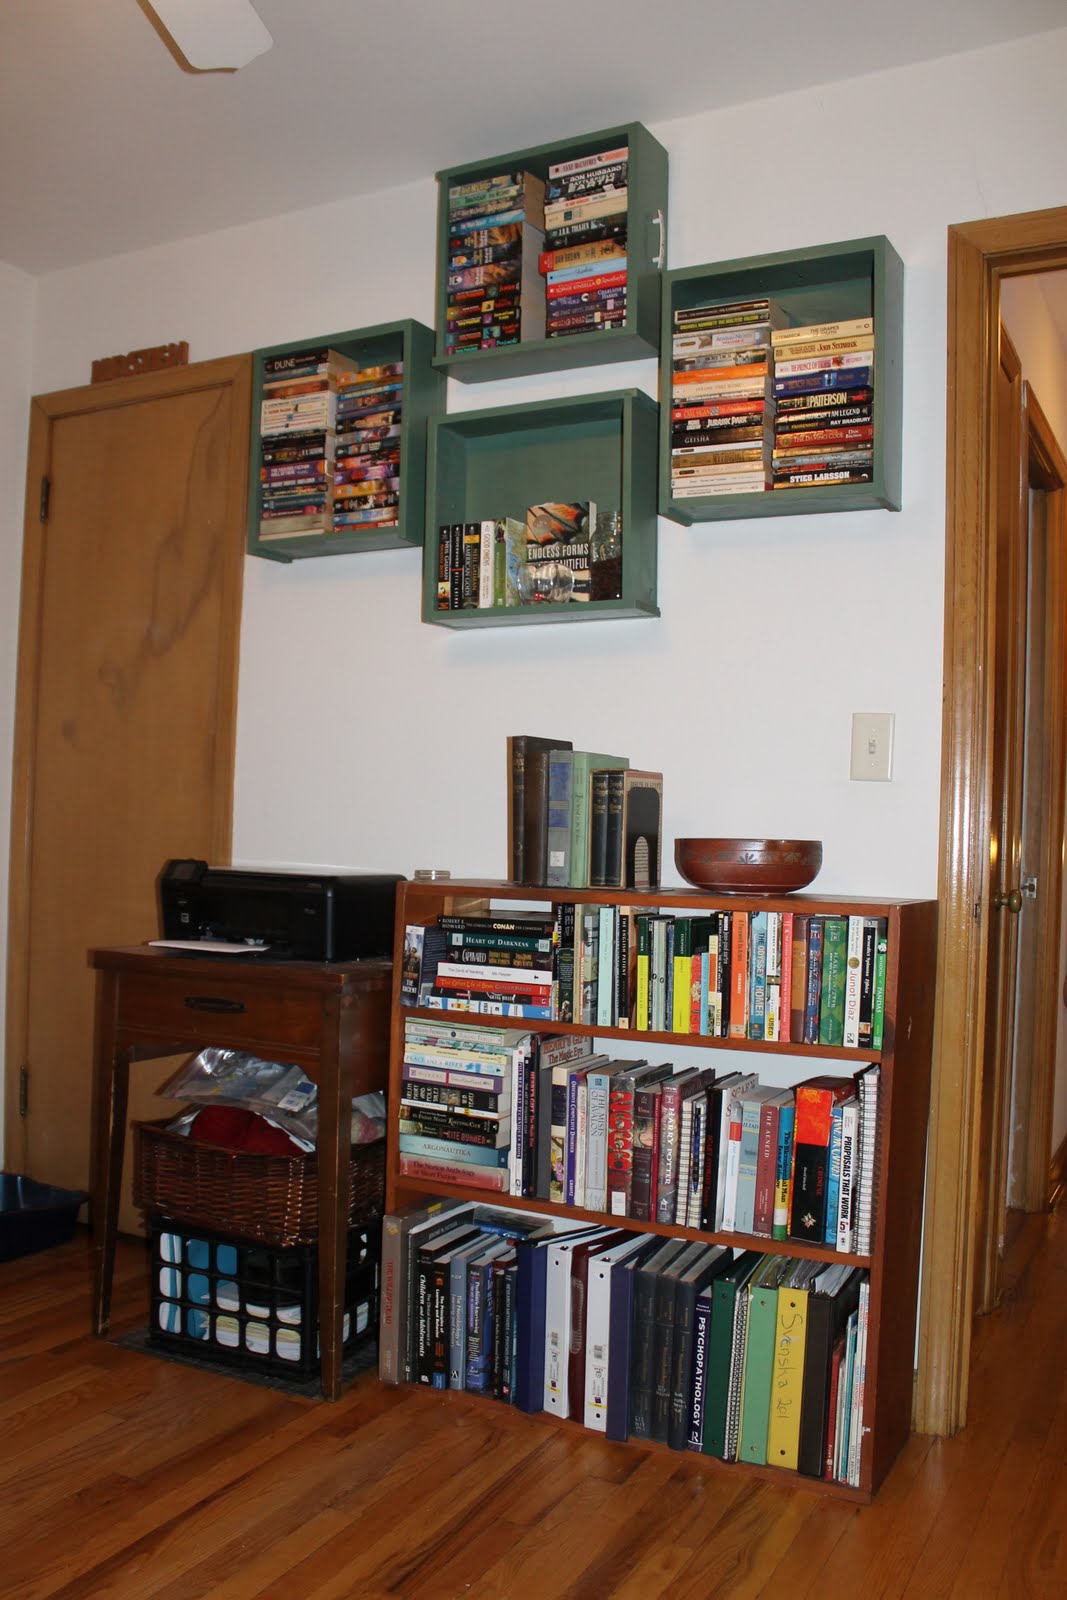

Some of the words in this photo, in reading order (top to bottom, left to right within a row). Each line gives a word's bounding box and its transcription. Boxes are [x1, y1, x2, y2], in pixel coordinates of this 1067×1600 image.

[570, 174, 585, 182] RON
[586, 166, 622, 178] HUBBARD
[568, 176, 614, 193] EARTH
[817, 344, 831, 352] JOHN
[832, 340, 858, 349] STEINBECK
[274, 358, 296, 370] DUNE
[810, 392, 847, 407] PATTERSON
[840, 408, 860, 416] LEGEND
[842, 416, 871, 424] BRADBURY
[707, 418, 731, 428] JURASSIC
[732, 416, 747, 425] PARK
[684, 436, 710, 444] GEISHA
[790, 474, 812, 483] STIEG
[814, 471, 850, 481] LARSSON
[528, 546, 561, 560] ENDLESS
[562, 543, 589, 556] FORMS
[497, 938, 529, 948] DARKNESS
[756, 945, 765, 978] ODYSSEY
[402, 986, 417, 994] ANCIENT
[440, 978, 450, 986] The
[452, 979, 465, 987] Other
[849, 970, 857, 997] Junot
[755, 985, 764, 1016] HOMER
[848, 1000, 858, 1020] Díaz
[591, 1090, 598, 1101] OF
[418, 1114, 433, 1122] FRIDAY
[590, 1103, 598, 1136] AVALON
[667, 1107, 675, 1145] HARRY
[447, 1130, 460, 1140] KITE
[461, 1133, 486, 1144] RUNNER
[423, 1143, 471, 1157] ARGONAUTIKA
[842, 1136, 852, 1177] PROPOSALS
[413, 1160, 424, 1168] The
[425, 1162, 445, 1170] Norton
[446, 1165, 475, 1176] Anthology
[665, 1148, 674, 1185] POTTER
[782, 1145, 790, 1187] Bicentennial
[842, 1179, 850, 1194] THAT
[841, 1195, 850, 1219] WORK
[778, 1314, 803, 1388] Svenska
[692, 1317, 706, 1426] PSYCHOPATHOLOGY
[776, 1400, 791, 1418] 201
